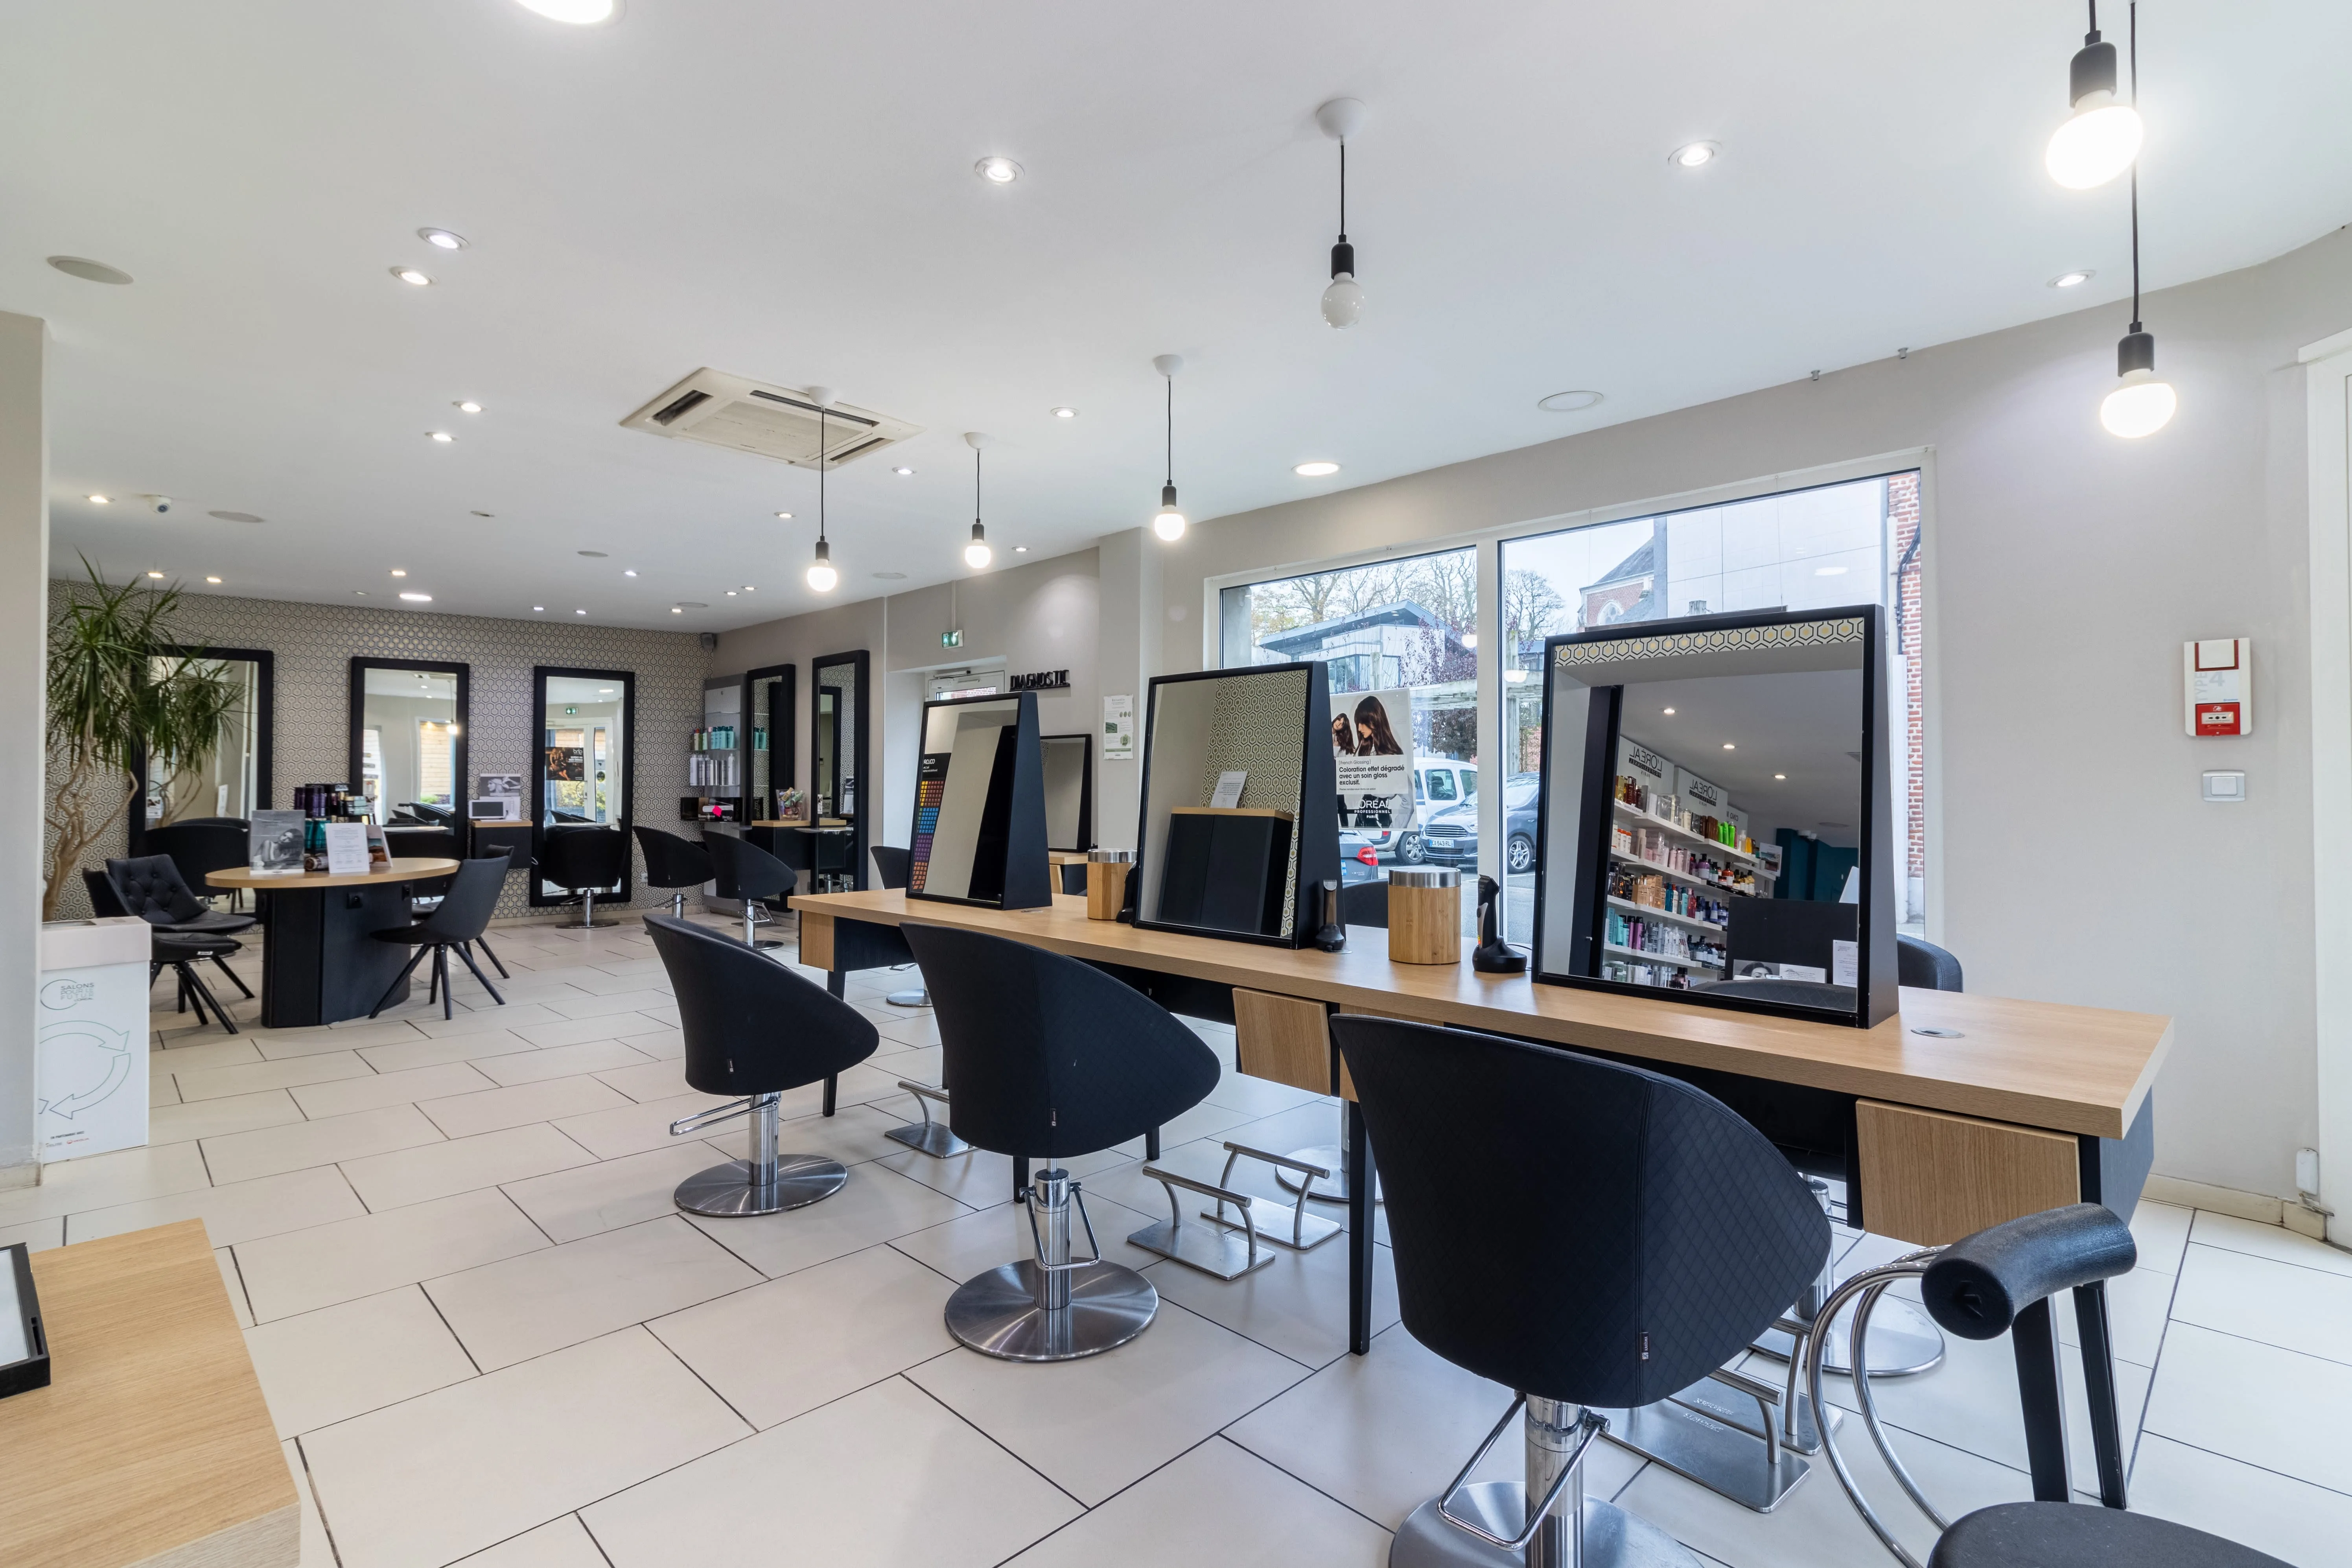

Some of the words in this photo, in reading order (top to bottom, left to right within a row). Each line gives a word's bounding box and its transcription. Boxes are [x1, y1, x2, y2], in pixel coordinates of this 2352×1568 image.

[1010, 669, 1070, 689] DIAGNOSTIC
[2194, 672, 2208, 702] TYPE
[2209, 671, 2225, 686] 4
